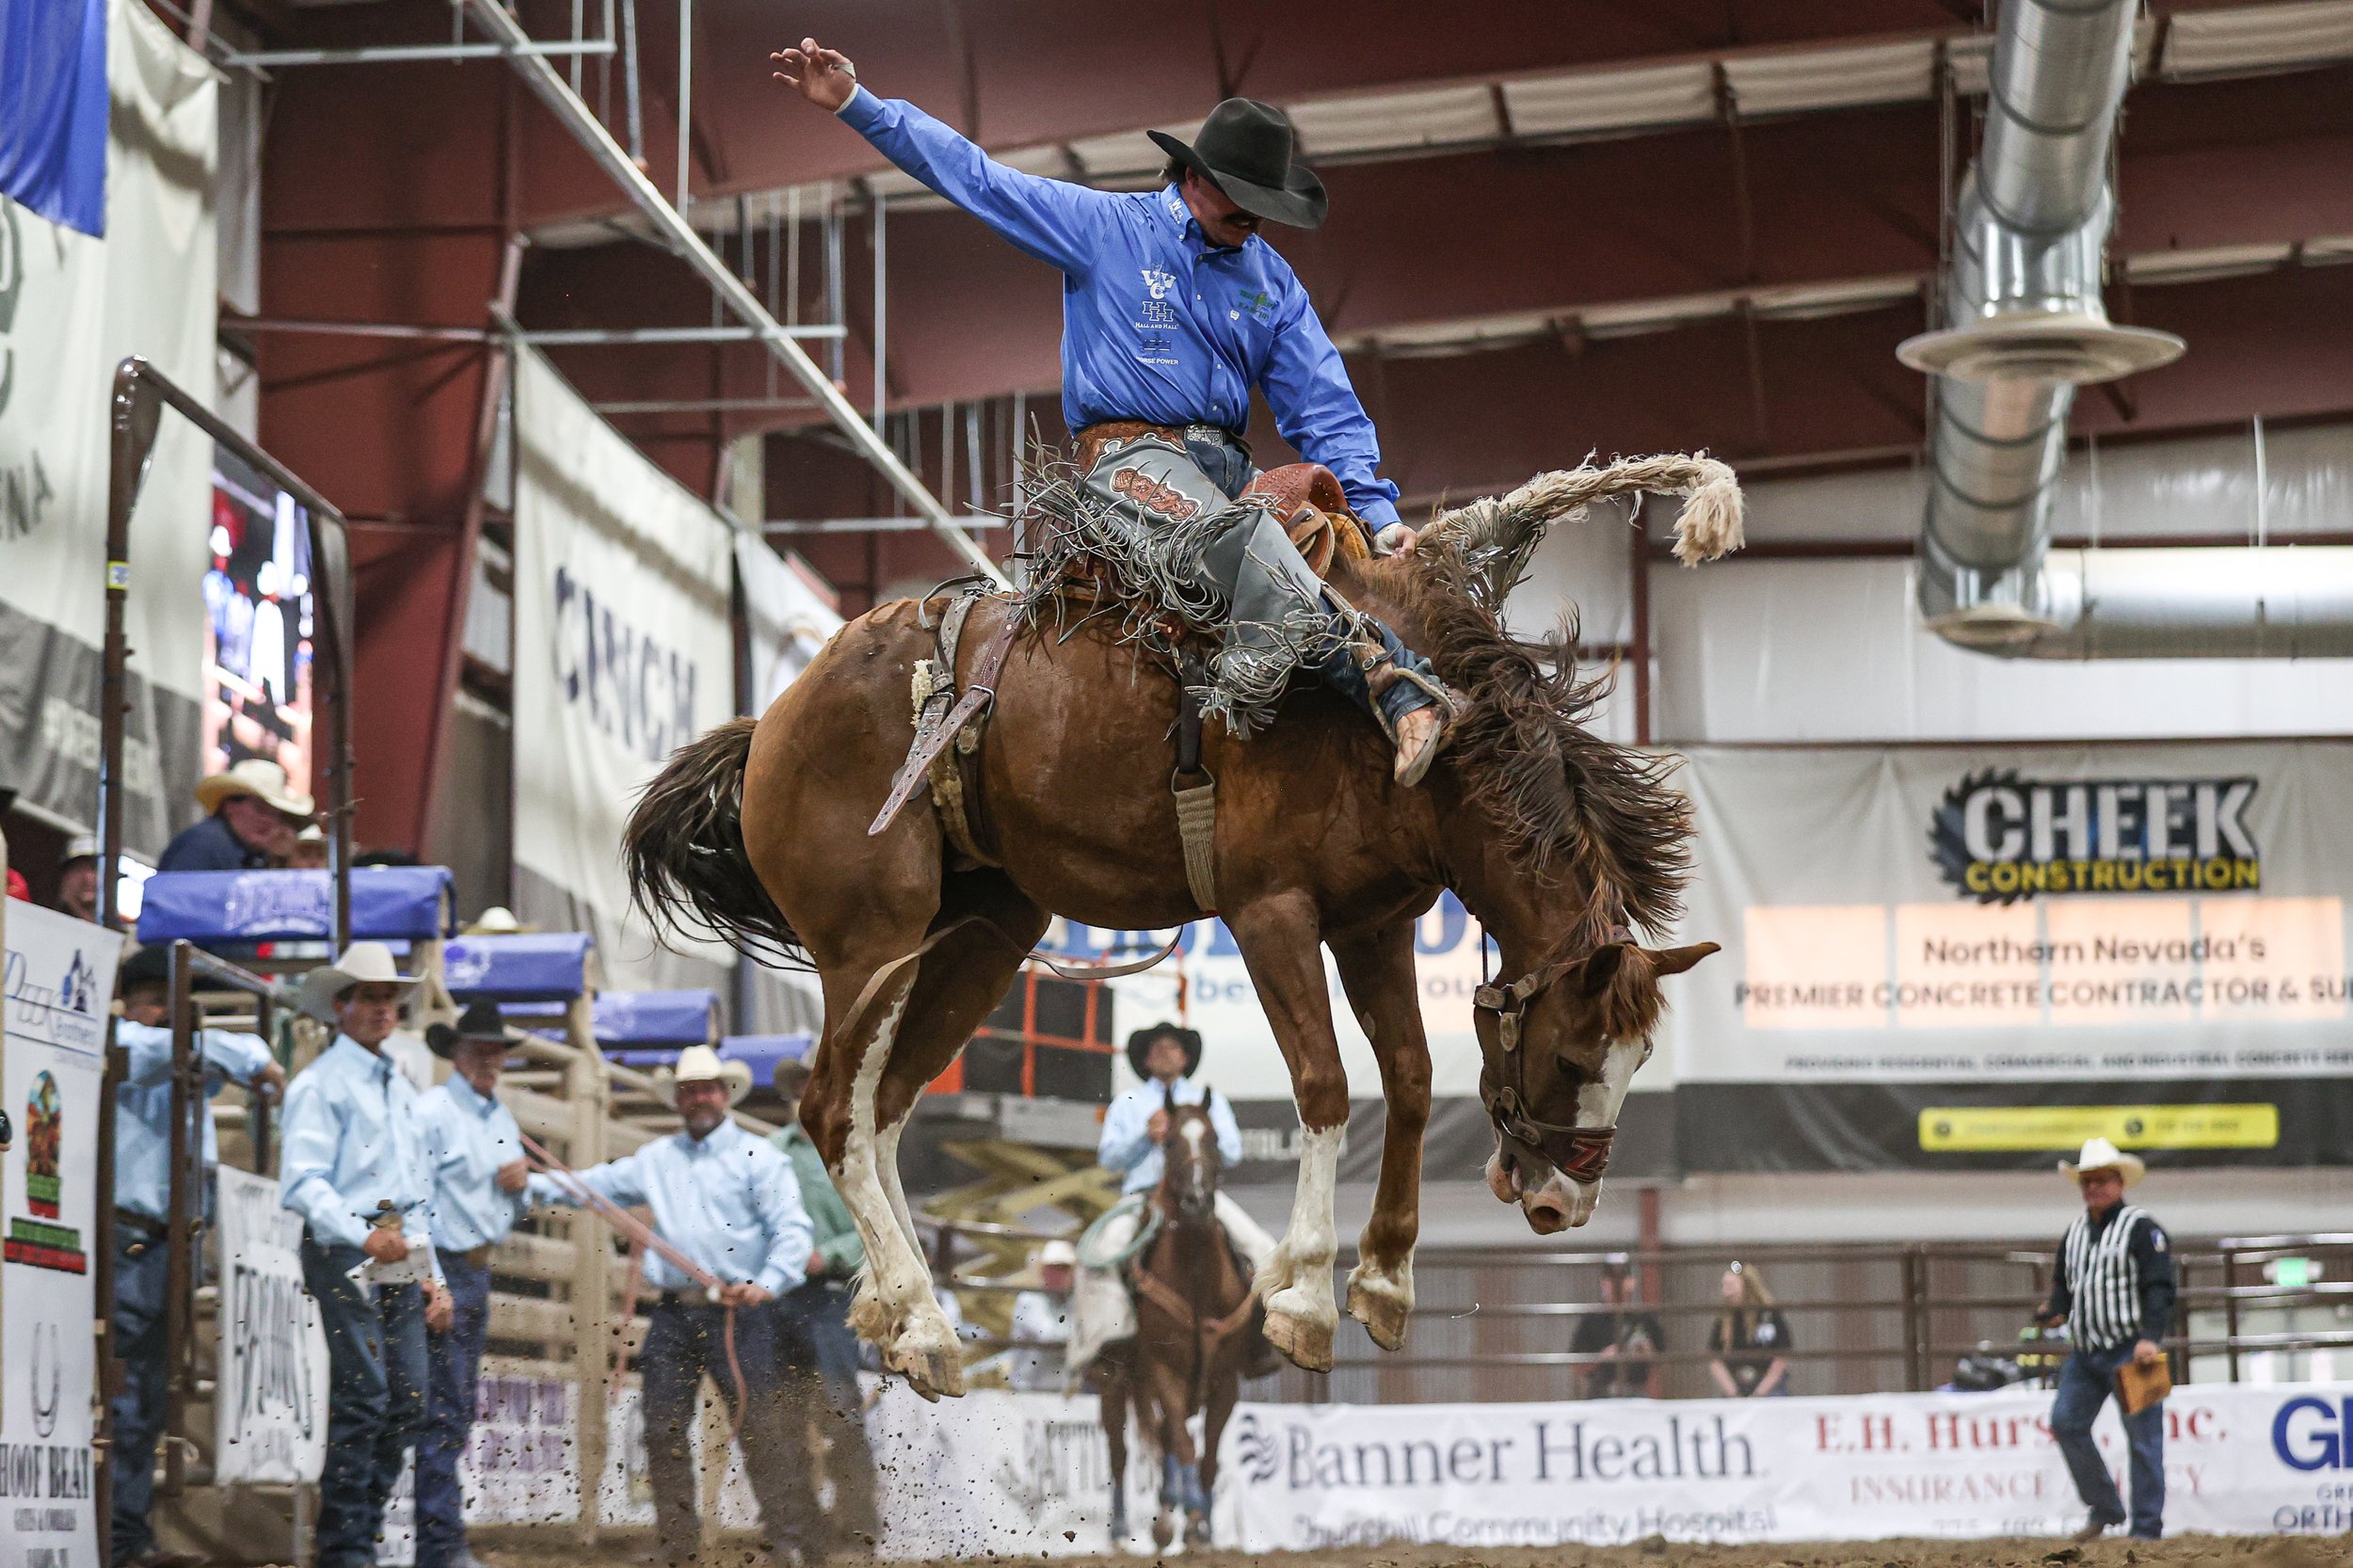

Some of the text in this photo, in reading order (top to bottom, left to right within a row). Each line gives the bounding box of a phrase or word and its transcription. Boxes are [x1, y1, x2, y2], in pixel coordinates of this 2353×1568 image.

[1963, 782, 2258, 859] CHEEK
[1966, 859, 2260, 893] CONSTRUCTION
[1923, 933, 2265, 966] Northern Nevada's
[1736, 977, 2353, 1009] PREMIER CONCRETE CONTRACTOR & SU
[1816, 1412, 1909, 1452] E.H.
[2163, 1406, 2227, 1442] nc.
[1287, 1414, 1758, 1489] Banner Health
[1850, 1469, 2047, 1503] INSURANCE
